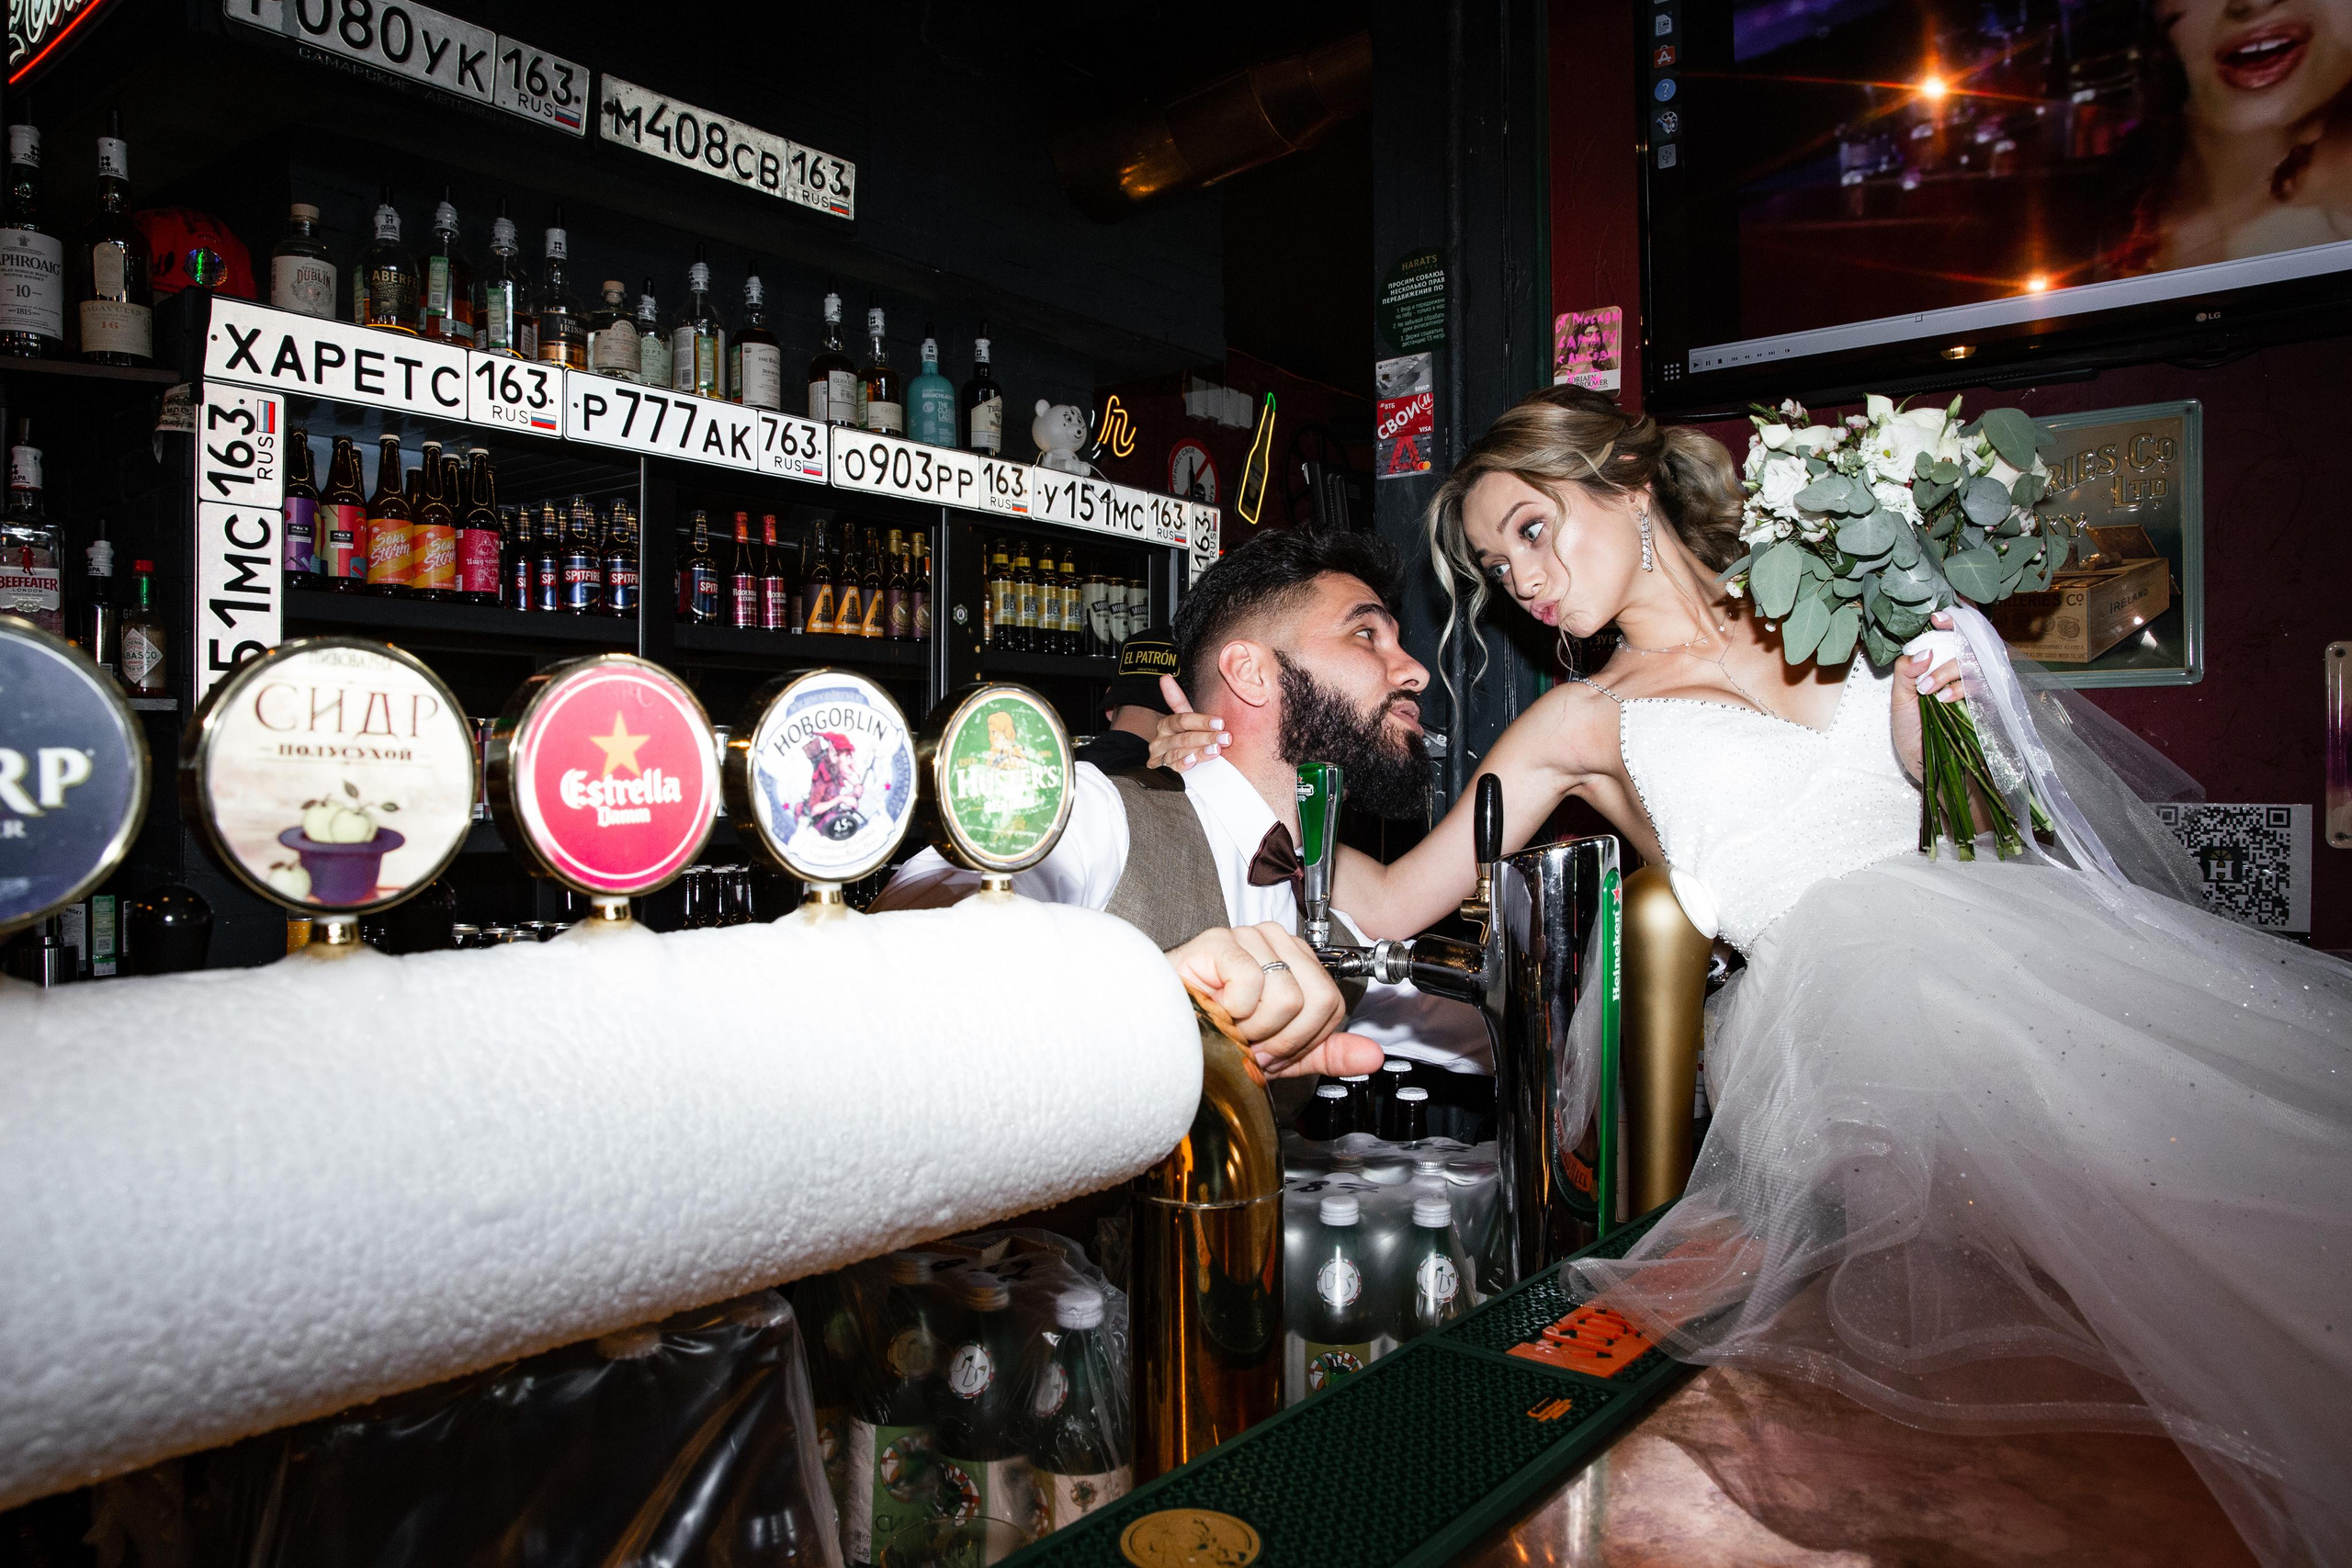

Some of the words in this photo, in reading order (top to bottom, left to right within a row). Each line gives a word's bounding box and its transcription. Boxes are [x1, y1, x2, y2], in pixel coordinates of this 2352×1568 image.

[502, 47, 575, 107] 163
[517, 93, 554, 118] RUS
[791, 150, 847, 197] 163
[801, 189, 830, 209] RUS
[16, 284, 31, 299] 10
[297, 268, 332, 292] DUBLIN
[1387, 276, 1415, 290] ПРОСИМ
[1390, 280, 1428, 296] НЕСКОЛЬКО
[1382, 287, 1432, 305] ПЕРЕДВИЖЕНИЯ
[562, 318, 573, 327] THE
[225, 322, 461, 408] ХАРЕТС
[475, 359, 548, 408] 163
[492, 404, 530, 424] RUS
[582, 387, 752, 462] Р777АК
[762, 415, 819, 458] 763
[207, 403, 256, 497] 163
[256, 435, 275, 481] RUS
[774, 456, 803, 473] RUS
[984, 462, 1024, 497] 163
[989, 496, 1012, 511] RUS
[1043, 479, 1145, 533] У151МС
[1149, 496, 1185, 531] 163
[1156, 526, 1174, 541] RUS
[565, 570, 601, 582] SPITFIRE
[2110, 587, 2150, 615] IRELAND
[1124, 651, 1134, 665] EL
[1135, 649, 1177, 667] PATRÓN
[254, 682, 439, 742] СИДР
[774, 707, 888, 757] HOBGOBLIN
[278, 742, 413, 761] ПОЛУСУХОЙ
[560, 768, 683, 809] Estrella
[597, 807, 651, 828] Damm
[1611, 908, 1621, 1003] Heineken
